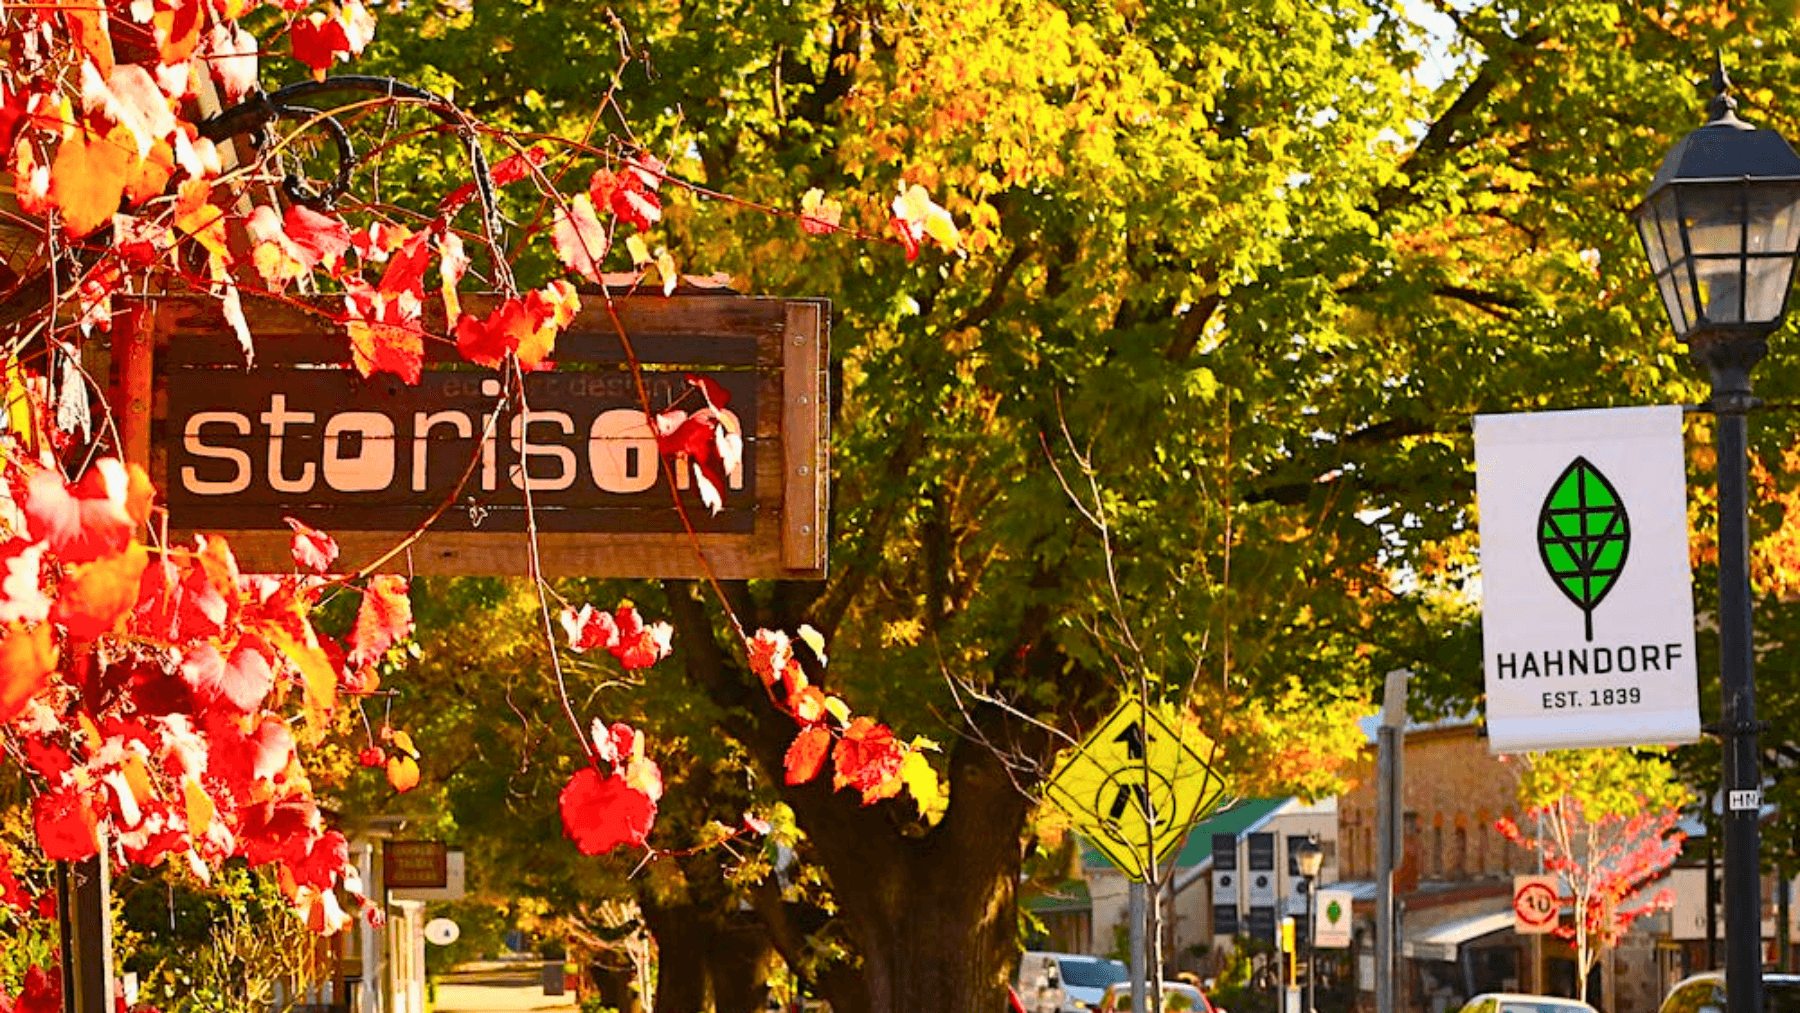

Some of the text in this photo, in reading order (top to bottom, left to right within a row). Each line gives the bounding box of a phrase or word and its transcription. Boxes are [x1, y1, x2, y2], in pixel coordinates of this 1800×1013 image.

[1497, 643, 1682, 680] HAHNDORF
[1541, 687, 1642, 710] EST. 1839
[1732, 793, 1756, 807] HN
[1526, 894, 1551, 914] 10
